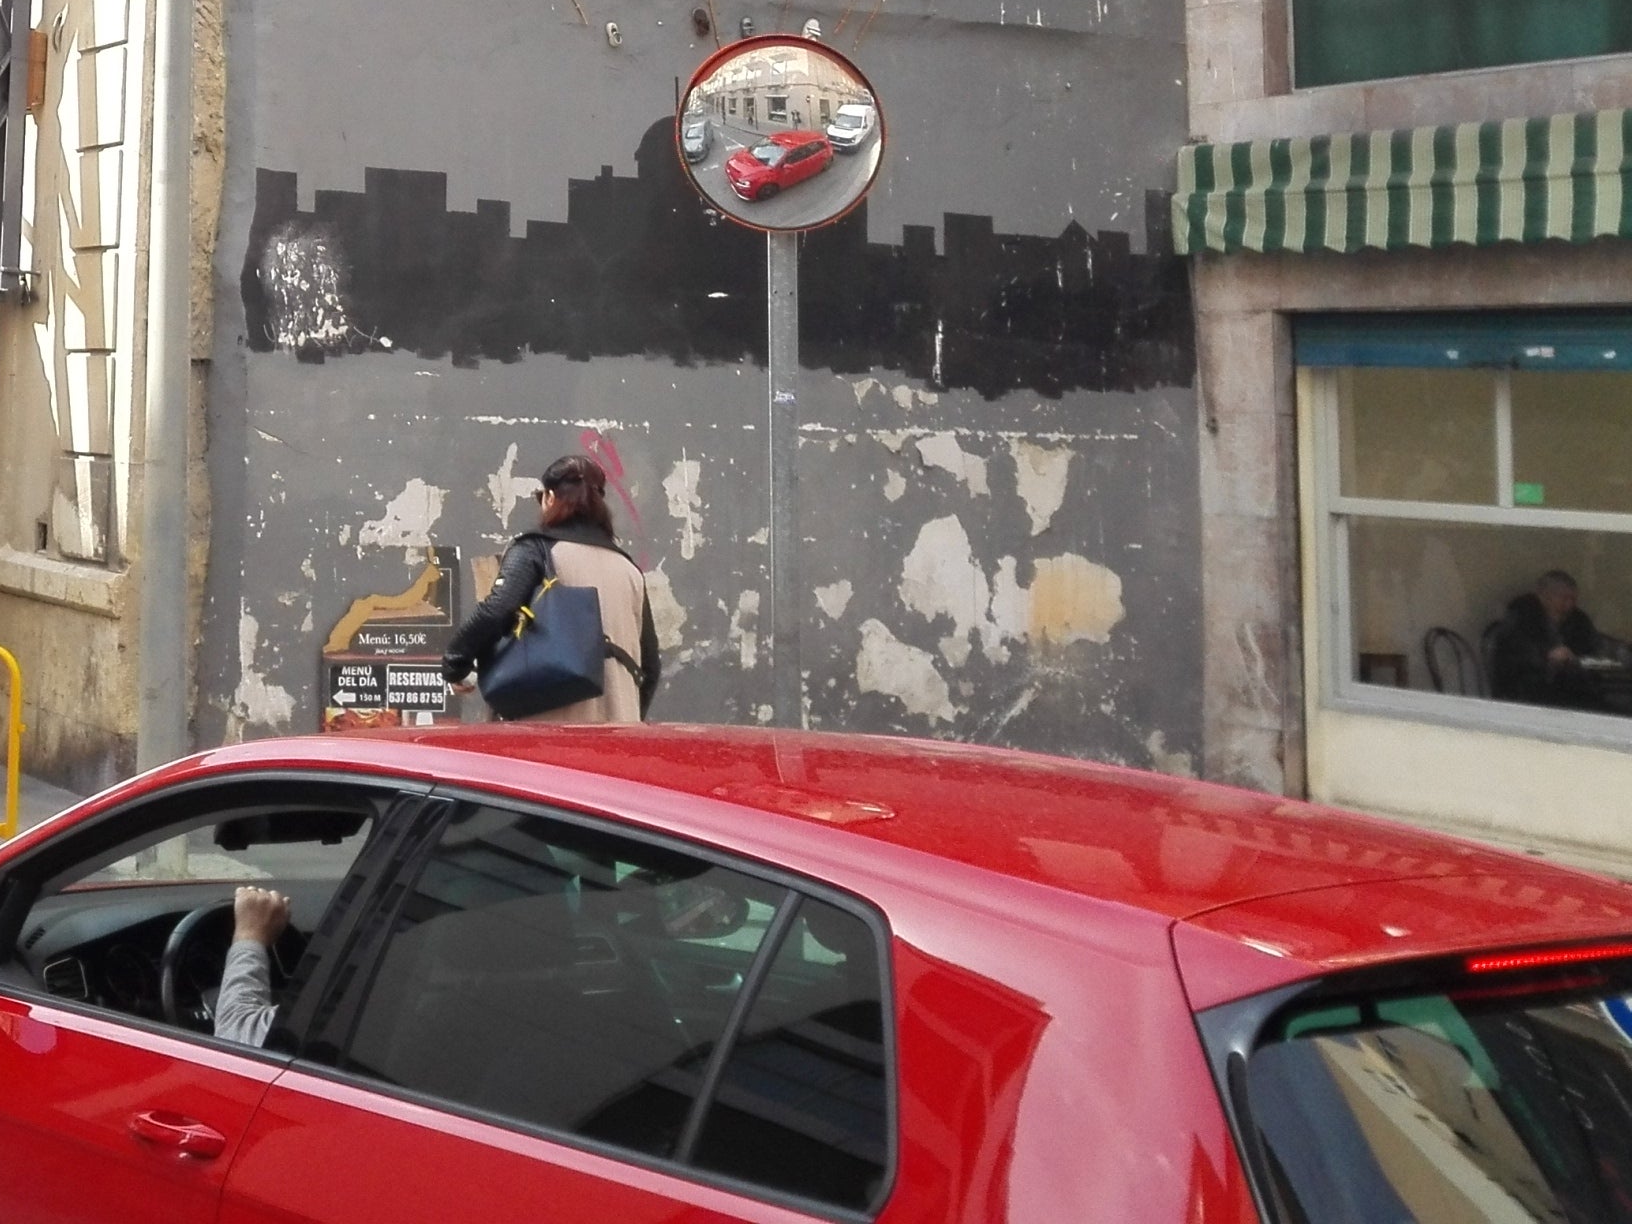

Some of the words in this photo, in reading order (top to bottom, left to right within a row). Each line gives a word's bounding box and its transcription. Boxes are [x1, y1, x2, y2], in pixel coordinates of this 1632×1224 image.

[358, 633, 391, 644] Menú:
[394, 633, 427, 646] 16,50€
[338, 676, 357, 686] DEL
[389, 672, 443, 686] RESERVAS
[374, 694, 381, 702] M
[389, 692, 405, 703] 637
[406, 692, 418, 703] 86
[419, 692, 430, 703] 87
[431, 692, 443, 704] 55
